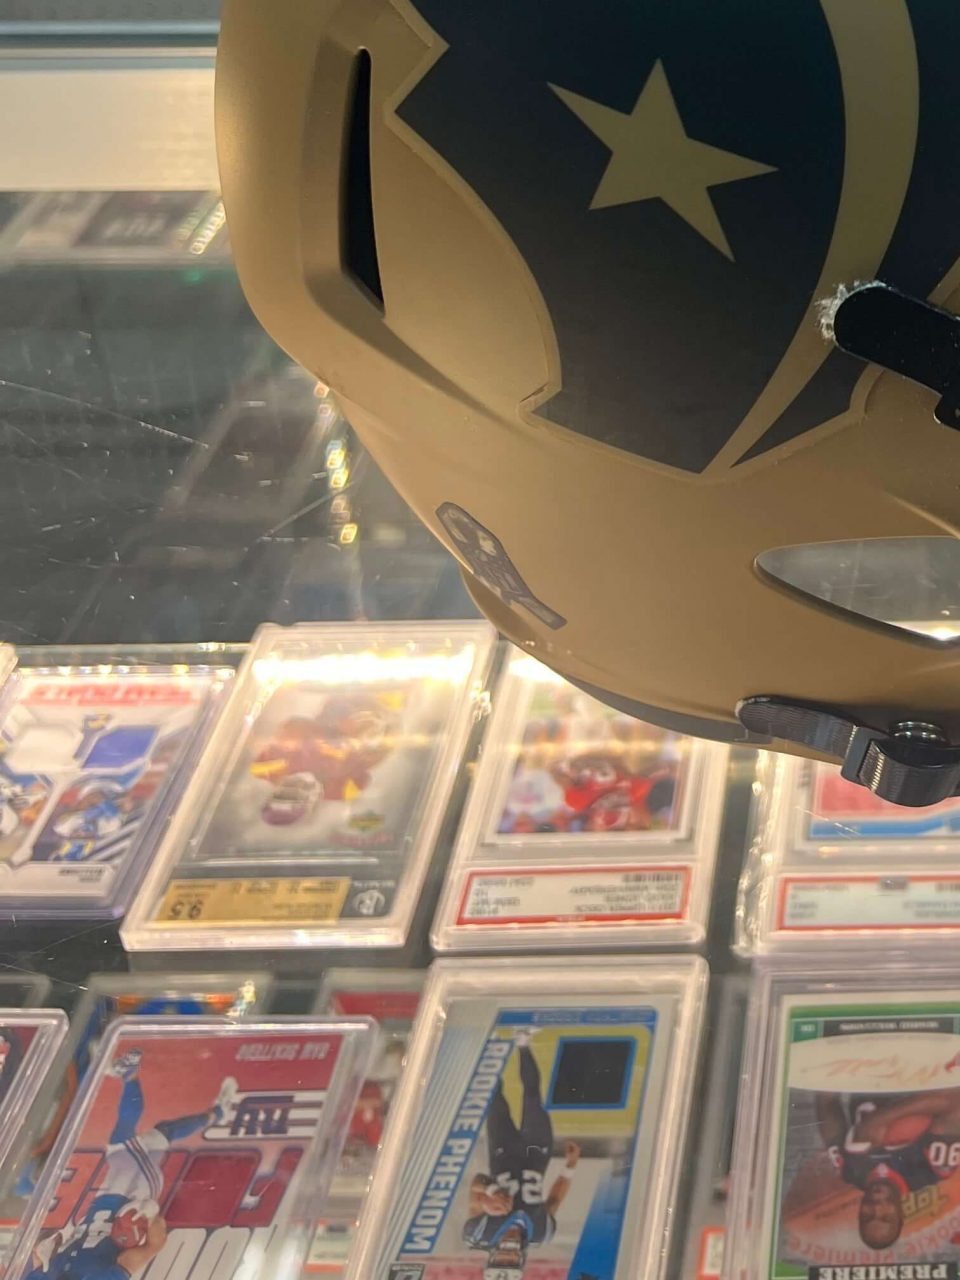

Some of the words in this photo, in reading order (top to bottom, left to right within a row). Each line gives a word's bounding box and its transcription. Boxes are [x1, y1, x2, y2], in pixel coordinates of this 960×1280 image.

[451, 1040, 509, 1132] ROOKIE
[402, 1138, 469, 1251] PHENOM
[818, 1263, 948, 1280] PREMIERE
